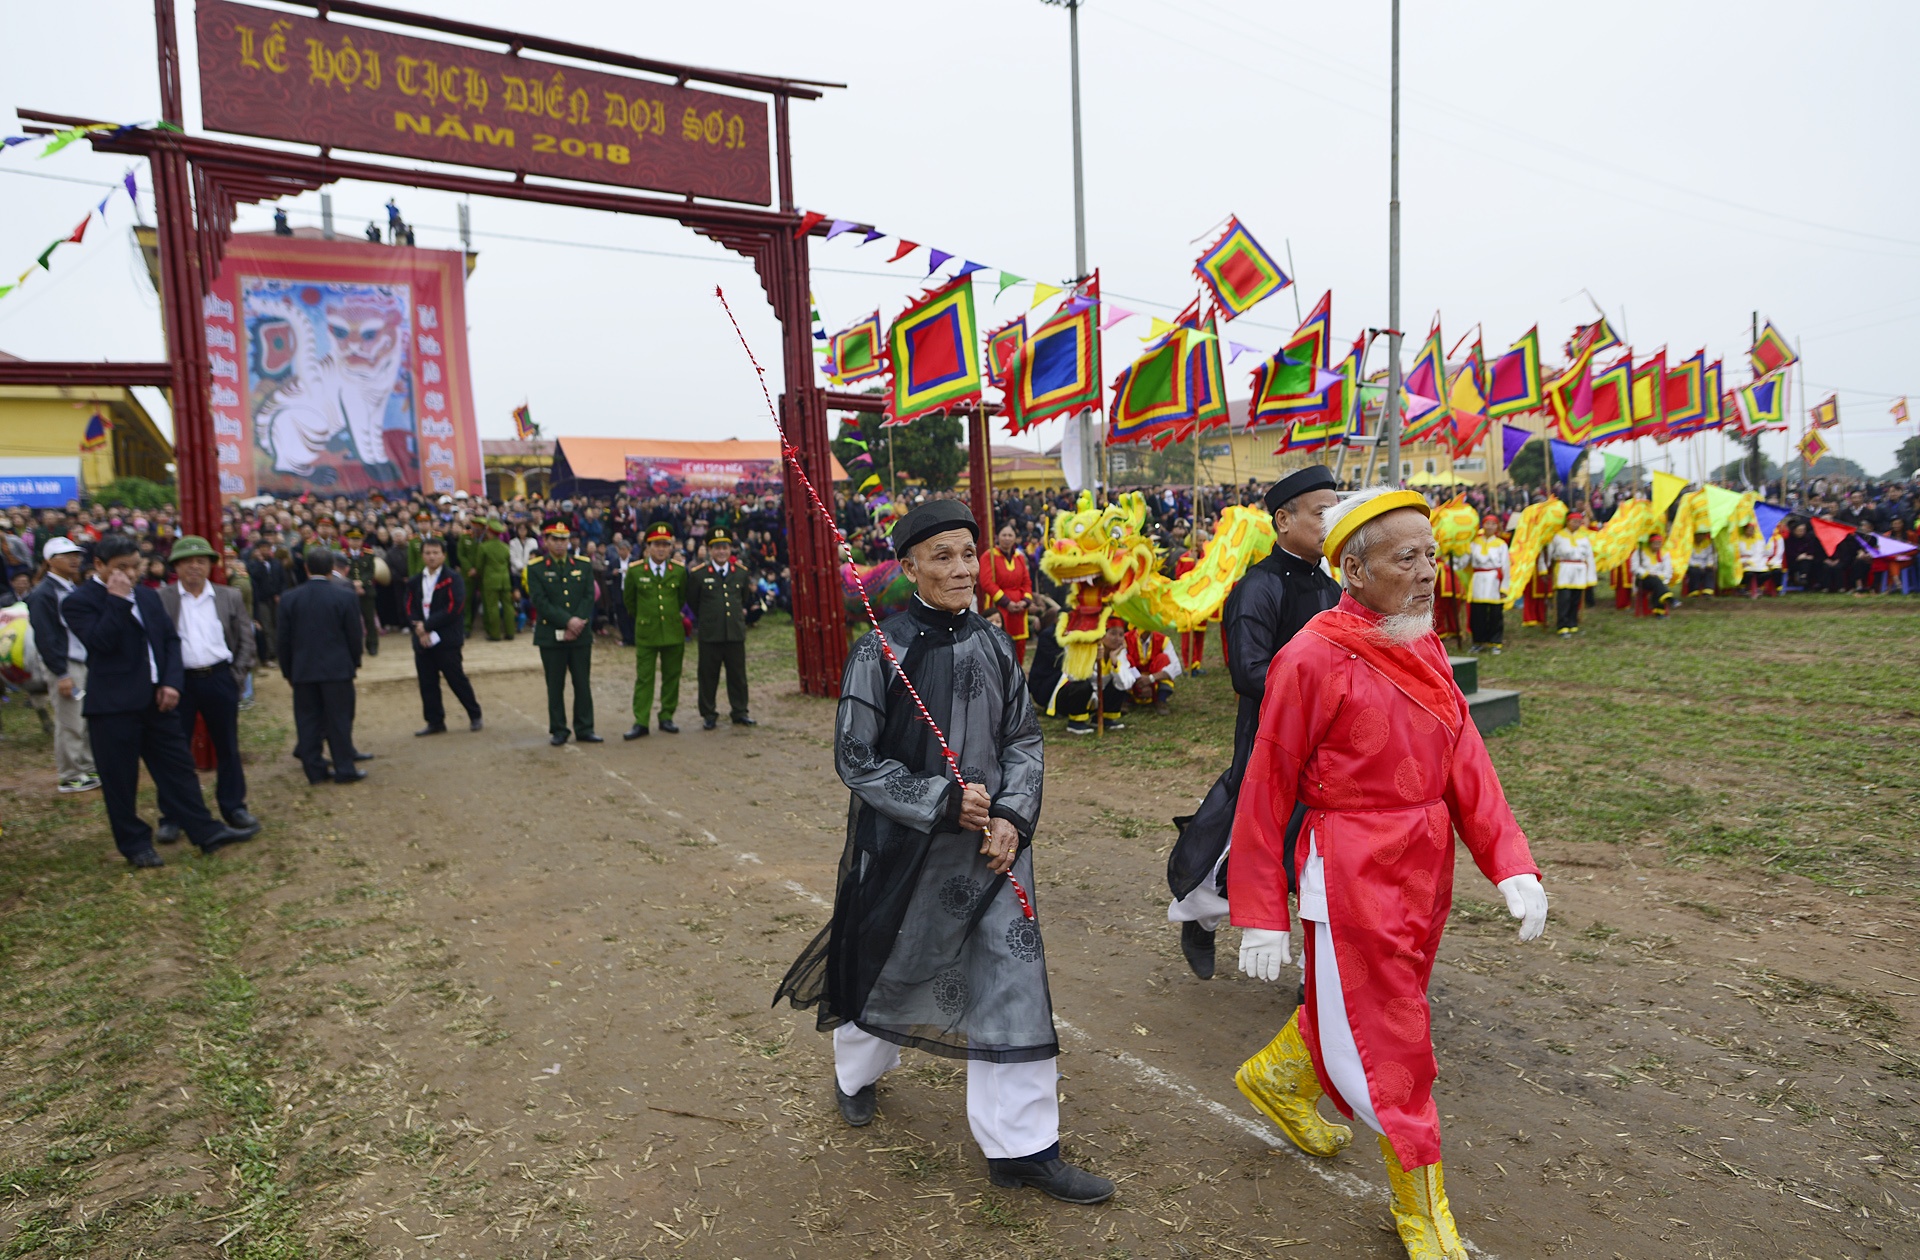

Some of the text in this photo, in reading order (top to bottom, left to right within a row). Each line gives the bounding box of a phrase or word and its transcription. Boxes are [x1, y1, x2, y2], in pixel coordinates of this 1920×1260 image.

[235, 19, 294, 74] LỄ
[305, 34, 383, 94] HỘI
[394, 111, 632, 165] NĂM 2018
